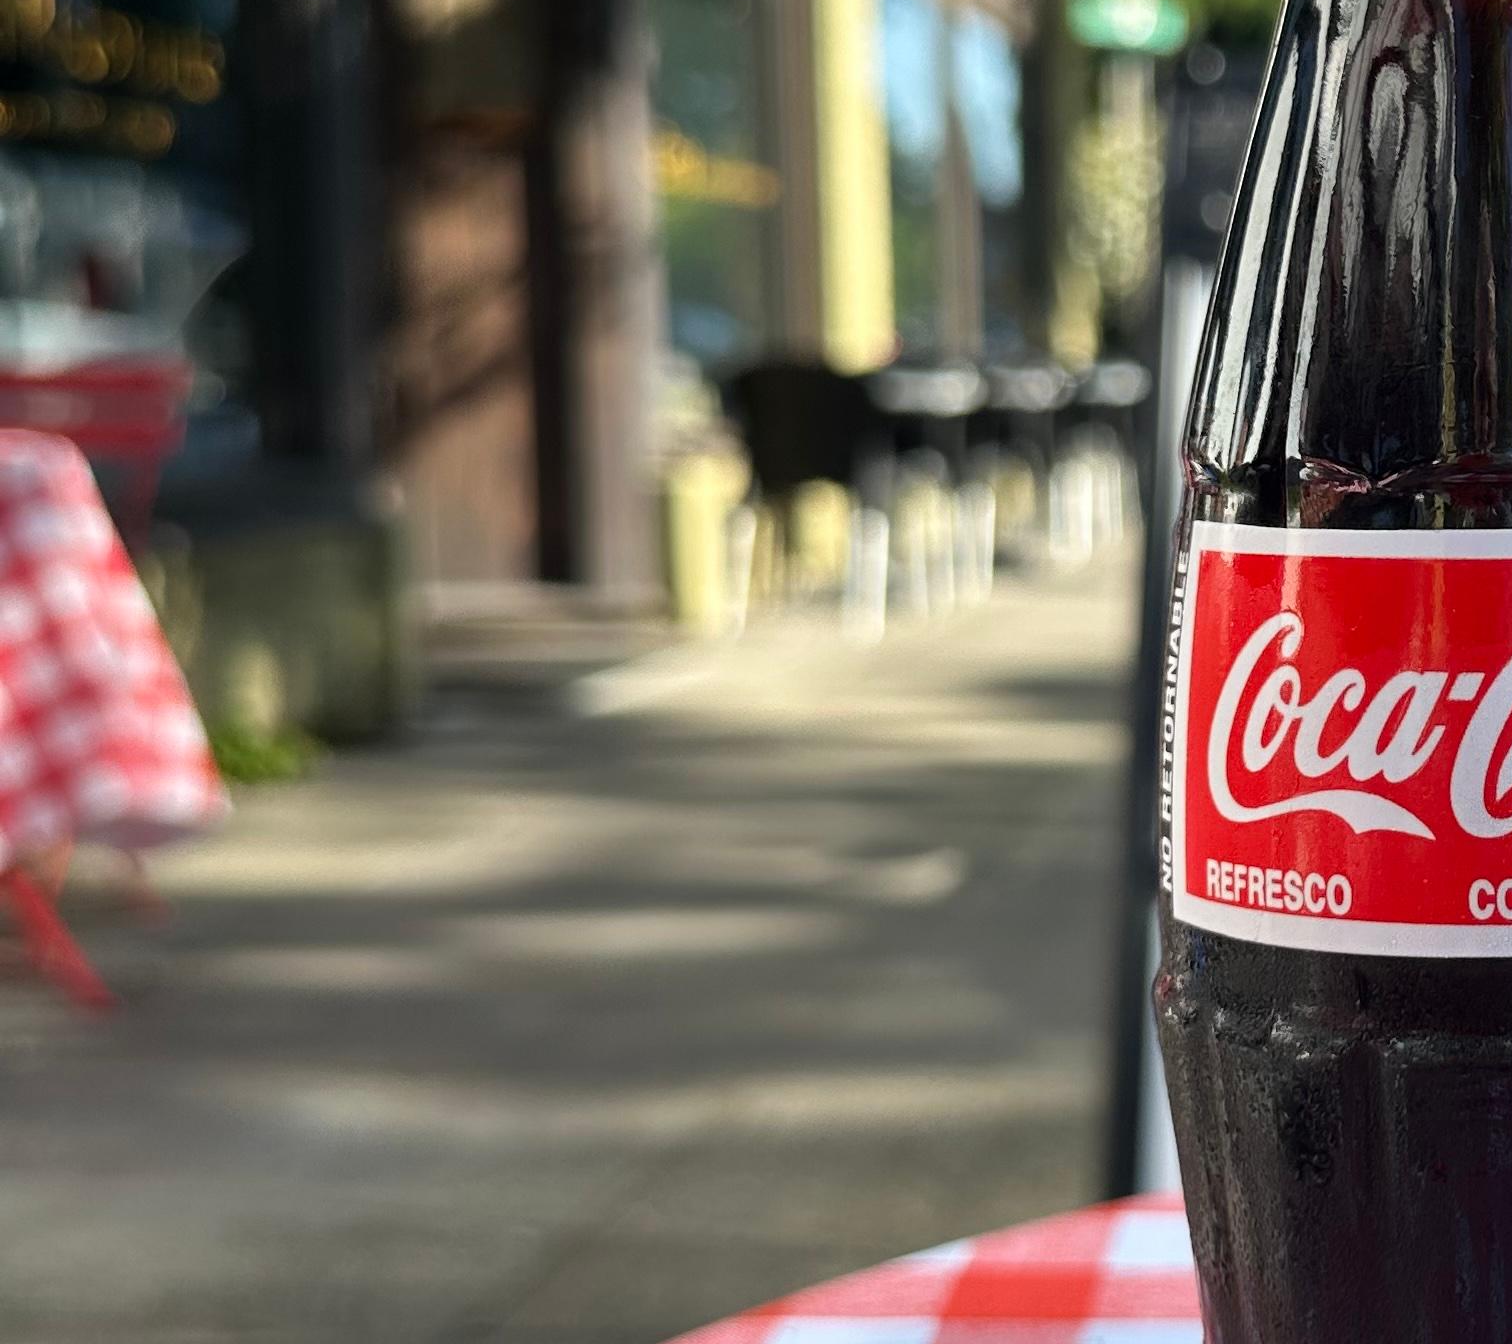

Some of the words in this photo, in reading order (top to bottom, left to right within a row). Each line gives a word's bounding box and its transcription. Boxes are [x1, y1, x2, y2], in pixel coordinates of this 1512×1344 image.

[1160, 549, 1189, 822] RETORNABLE
[1160, 834, 1174, 893] NO
[1206, 858, 1353, 916] REFRESCO
